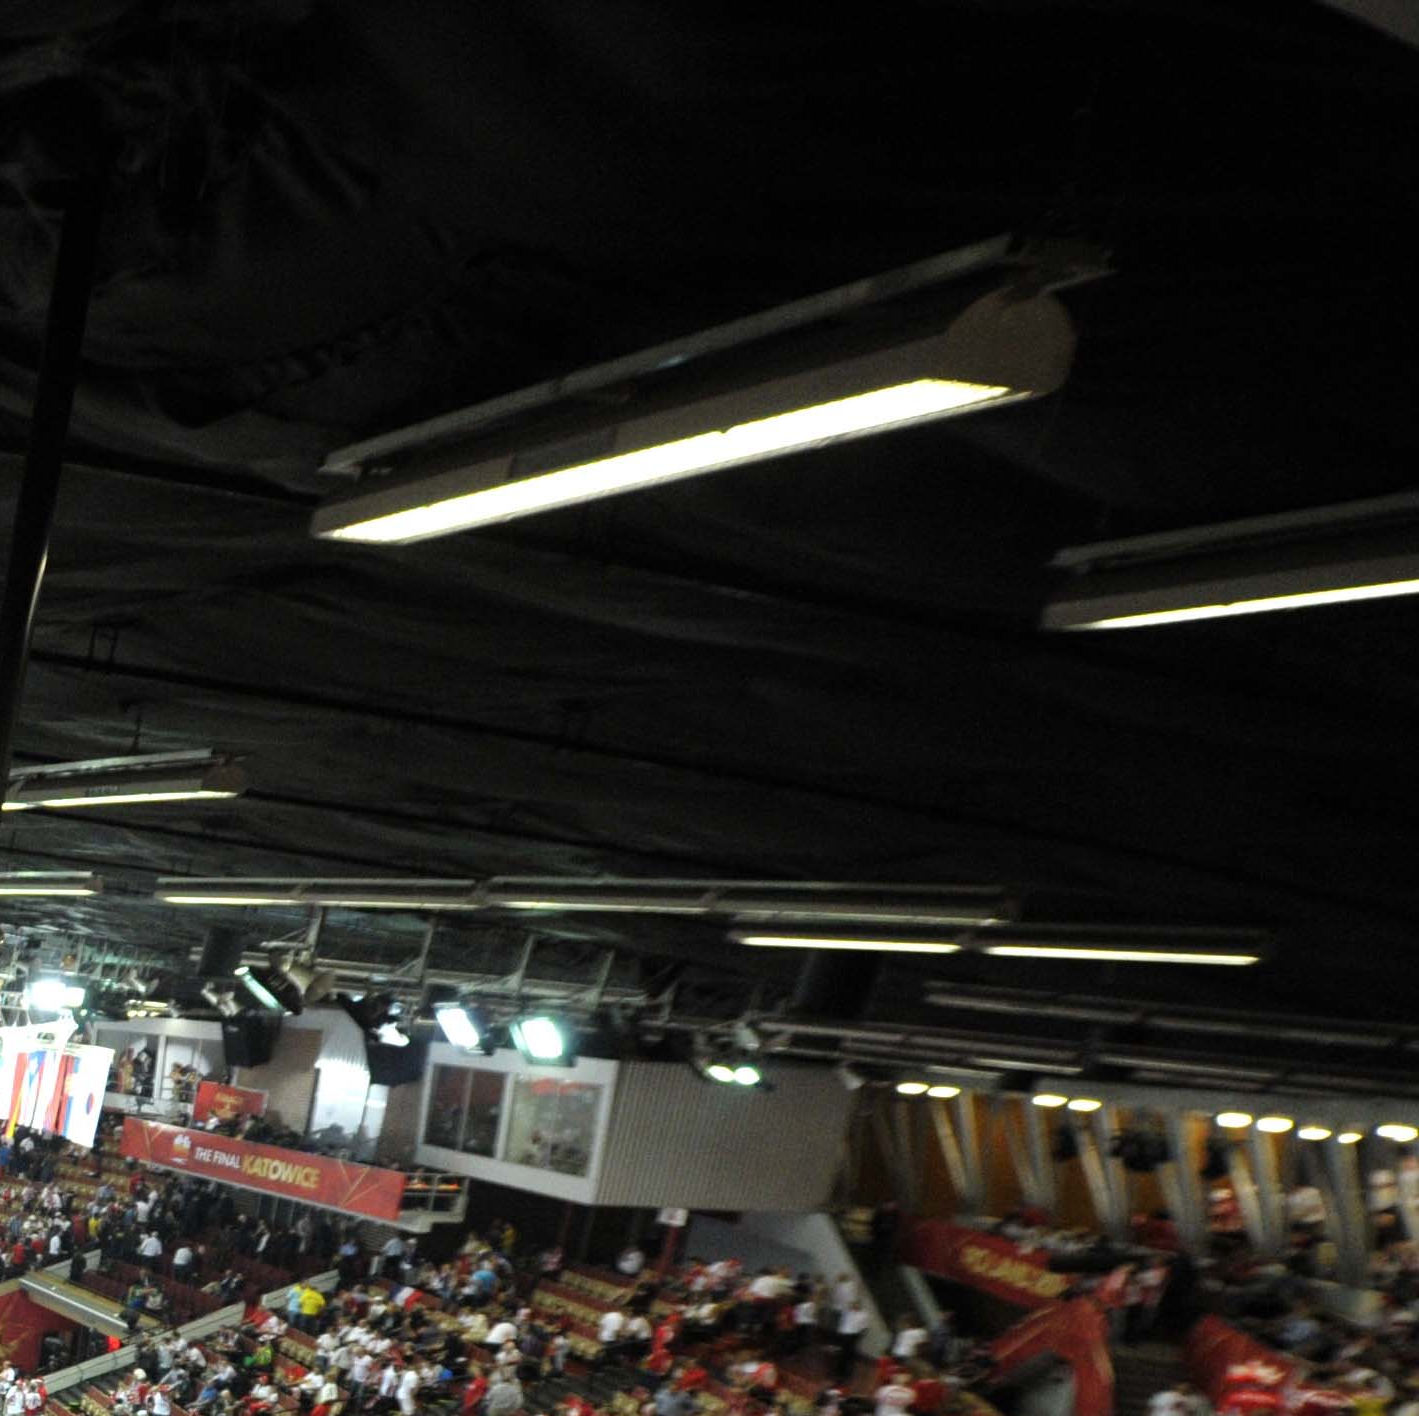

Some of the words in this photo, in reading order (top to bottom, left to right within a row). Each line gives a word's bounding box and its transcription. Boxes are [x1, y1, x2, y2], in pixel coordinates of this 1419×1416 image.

[194, 1146, 213, 1163] THE
[213, 1150, 242, 1170] FINAL
[242, 1153, 321, 1189] KATOWICE
